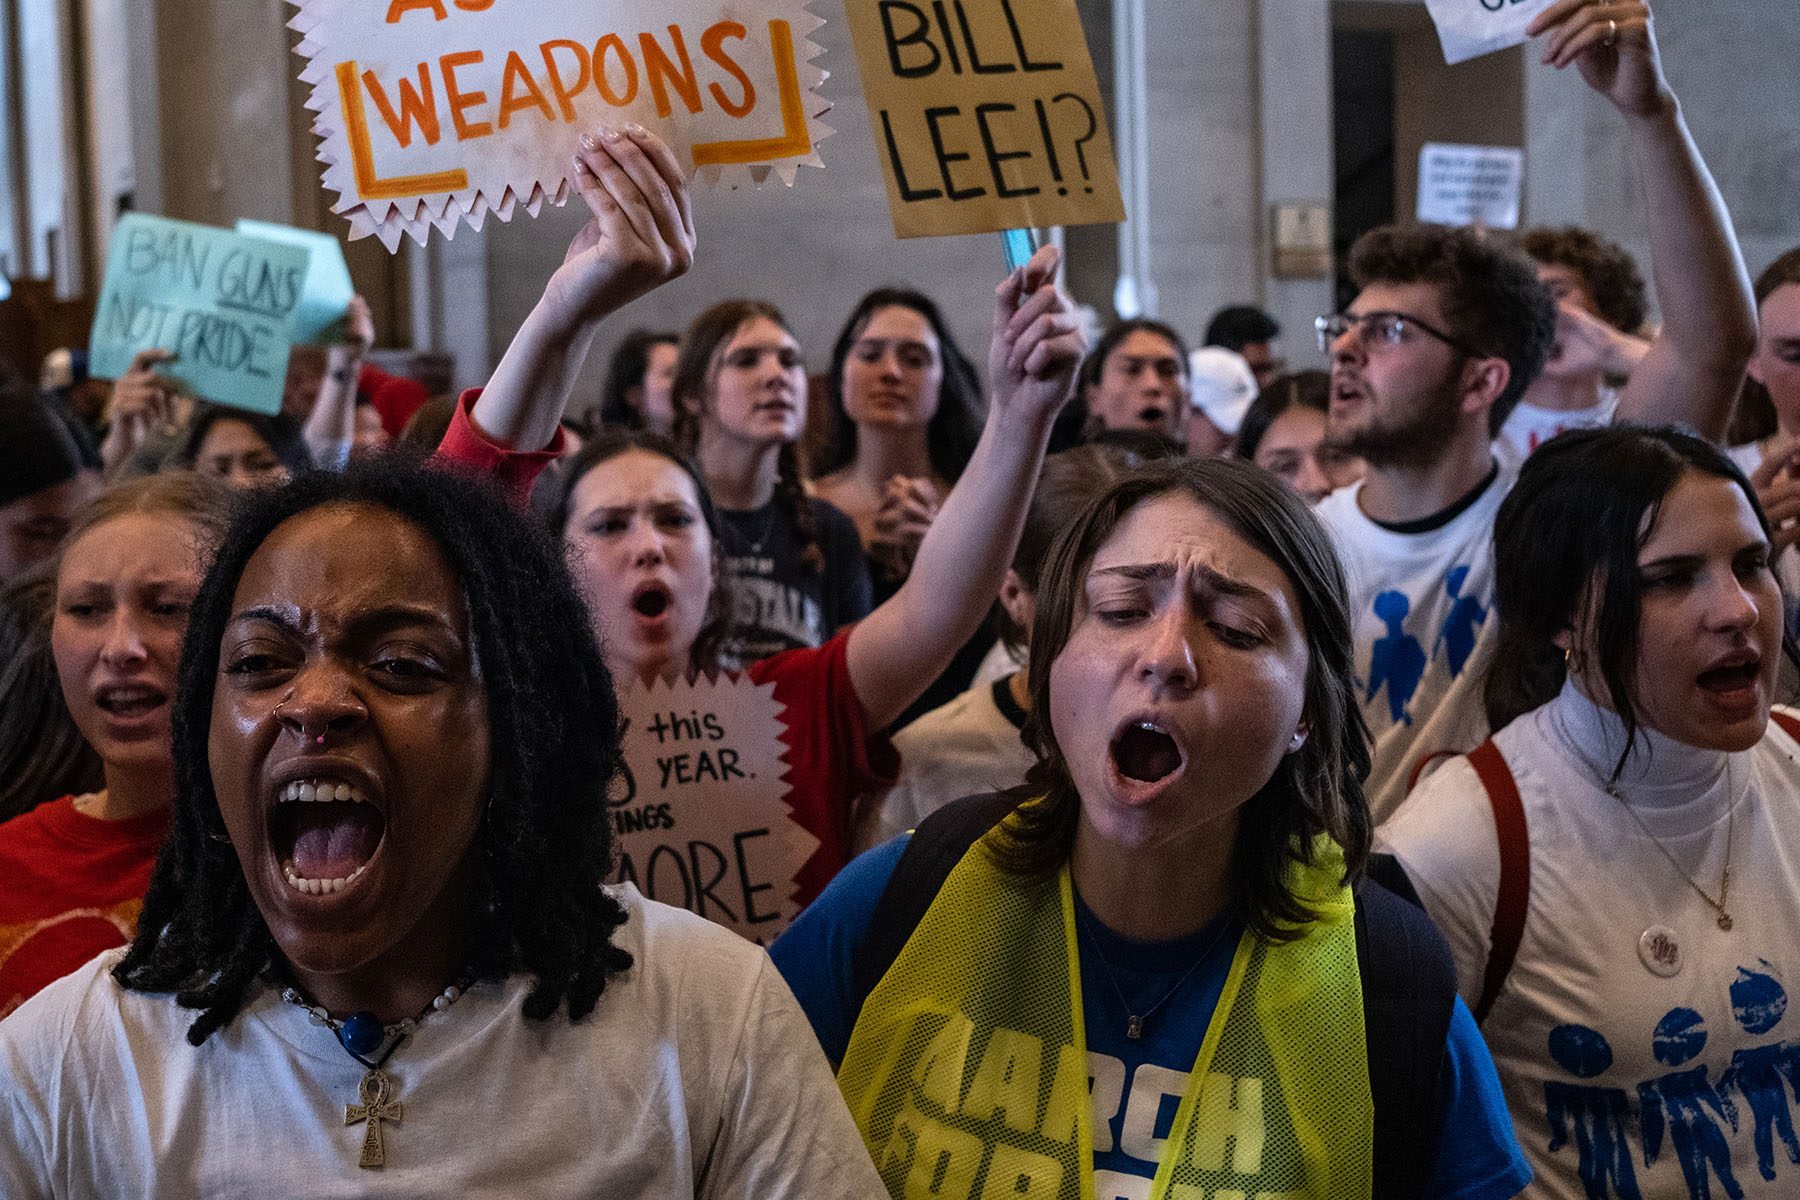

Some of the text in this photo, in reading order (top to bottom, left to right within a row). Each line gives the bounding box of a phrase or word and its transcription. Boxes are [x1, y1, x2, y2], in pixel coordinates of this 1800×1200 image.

[878, 0, 1064, 78] BILL
[361, 21, 756, 149] WEAPONS
[879, 92, 1097, 202] LEE!?
[126, 228, 301, 316] BAN GUNS
[106, 291, 274, 380] NOT PRIDE
[647, 709, 725, 744] this
[656, 748, 757, 790] YEAR.
[614, 802, 676, 835] INGS
